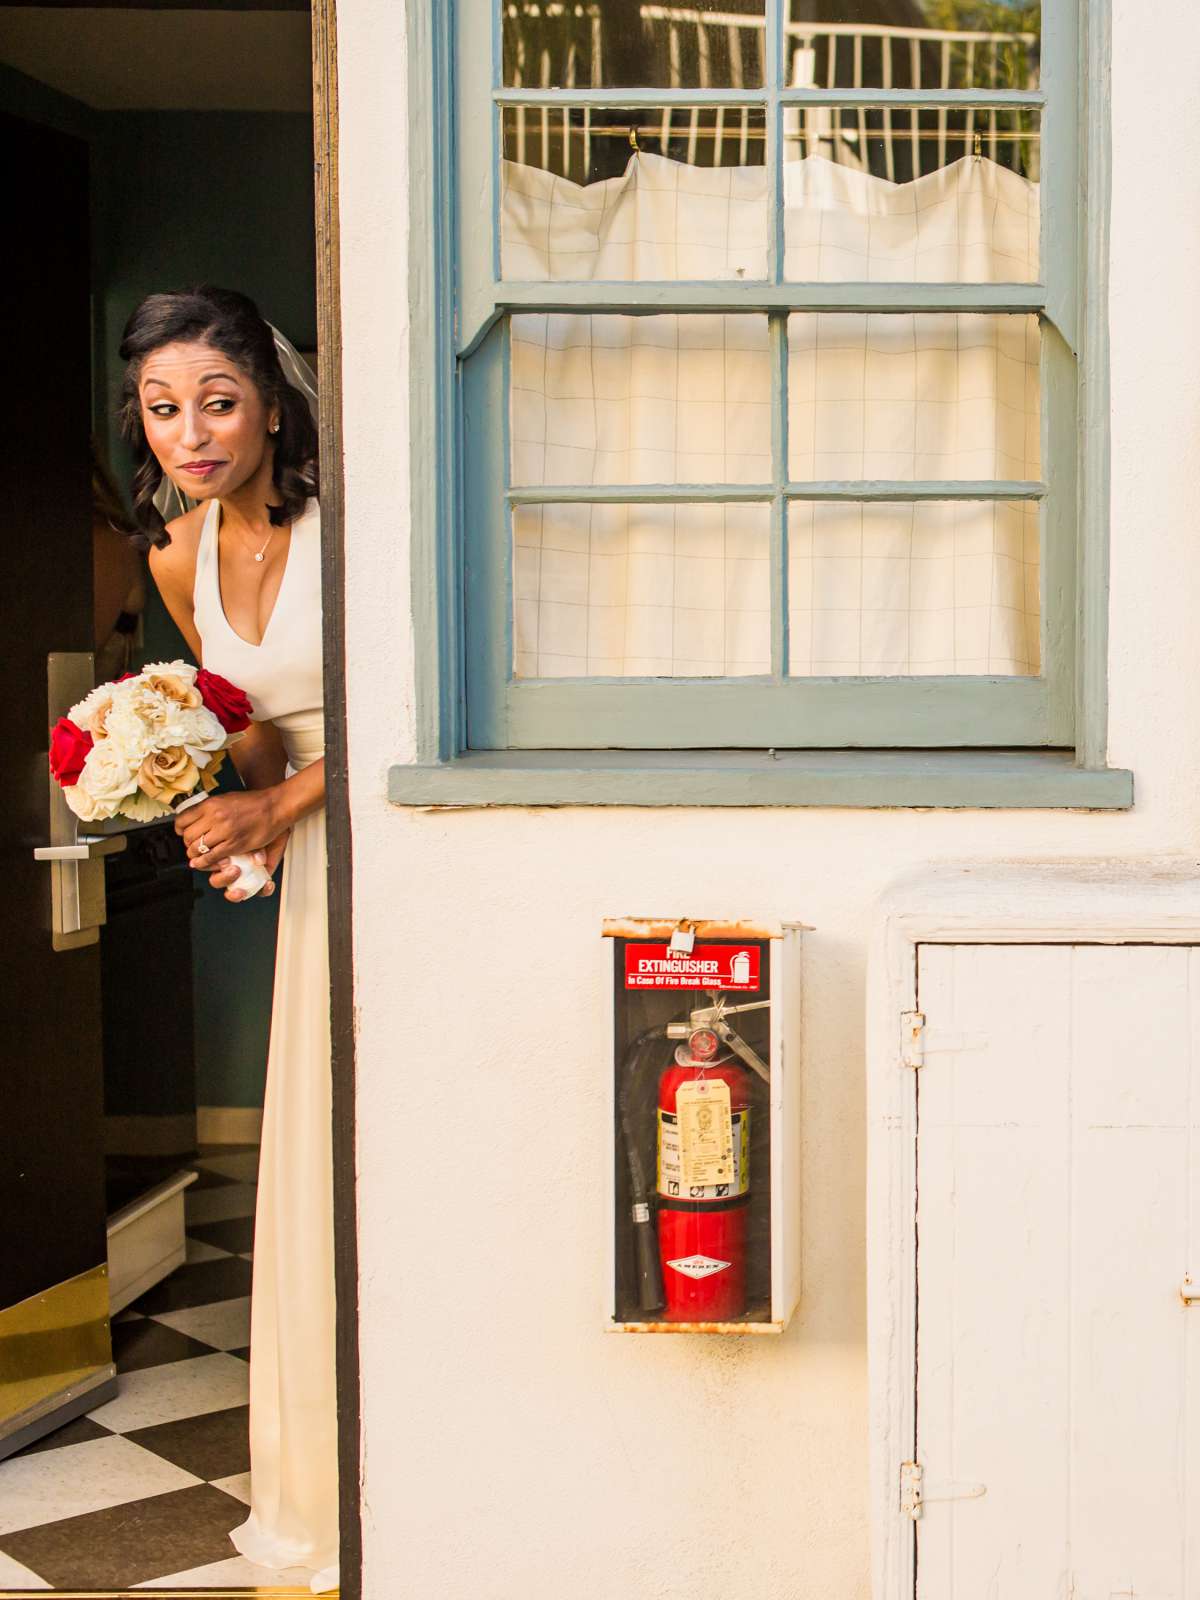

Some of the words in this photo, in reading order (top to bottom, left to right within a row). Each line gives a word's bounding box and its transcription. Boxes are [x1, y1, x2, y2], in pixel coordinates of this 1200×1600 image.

[639, 960, 718, 973] EXTINGUISHER
[628, 976, 635, 985] In
[636, 976, 654, 985] Case
[655, 976, 665, 985] Of
[665, 976, 680, 985] Fire
[680, 976, 701, 986] Break
[702, 977, 722, 986] Glass
